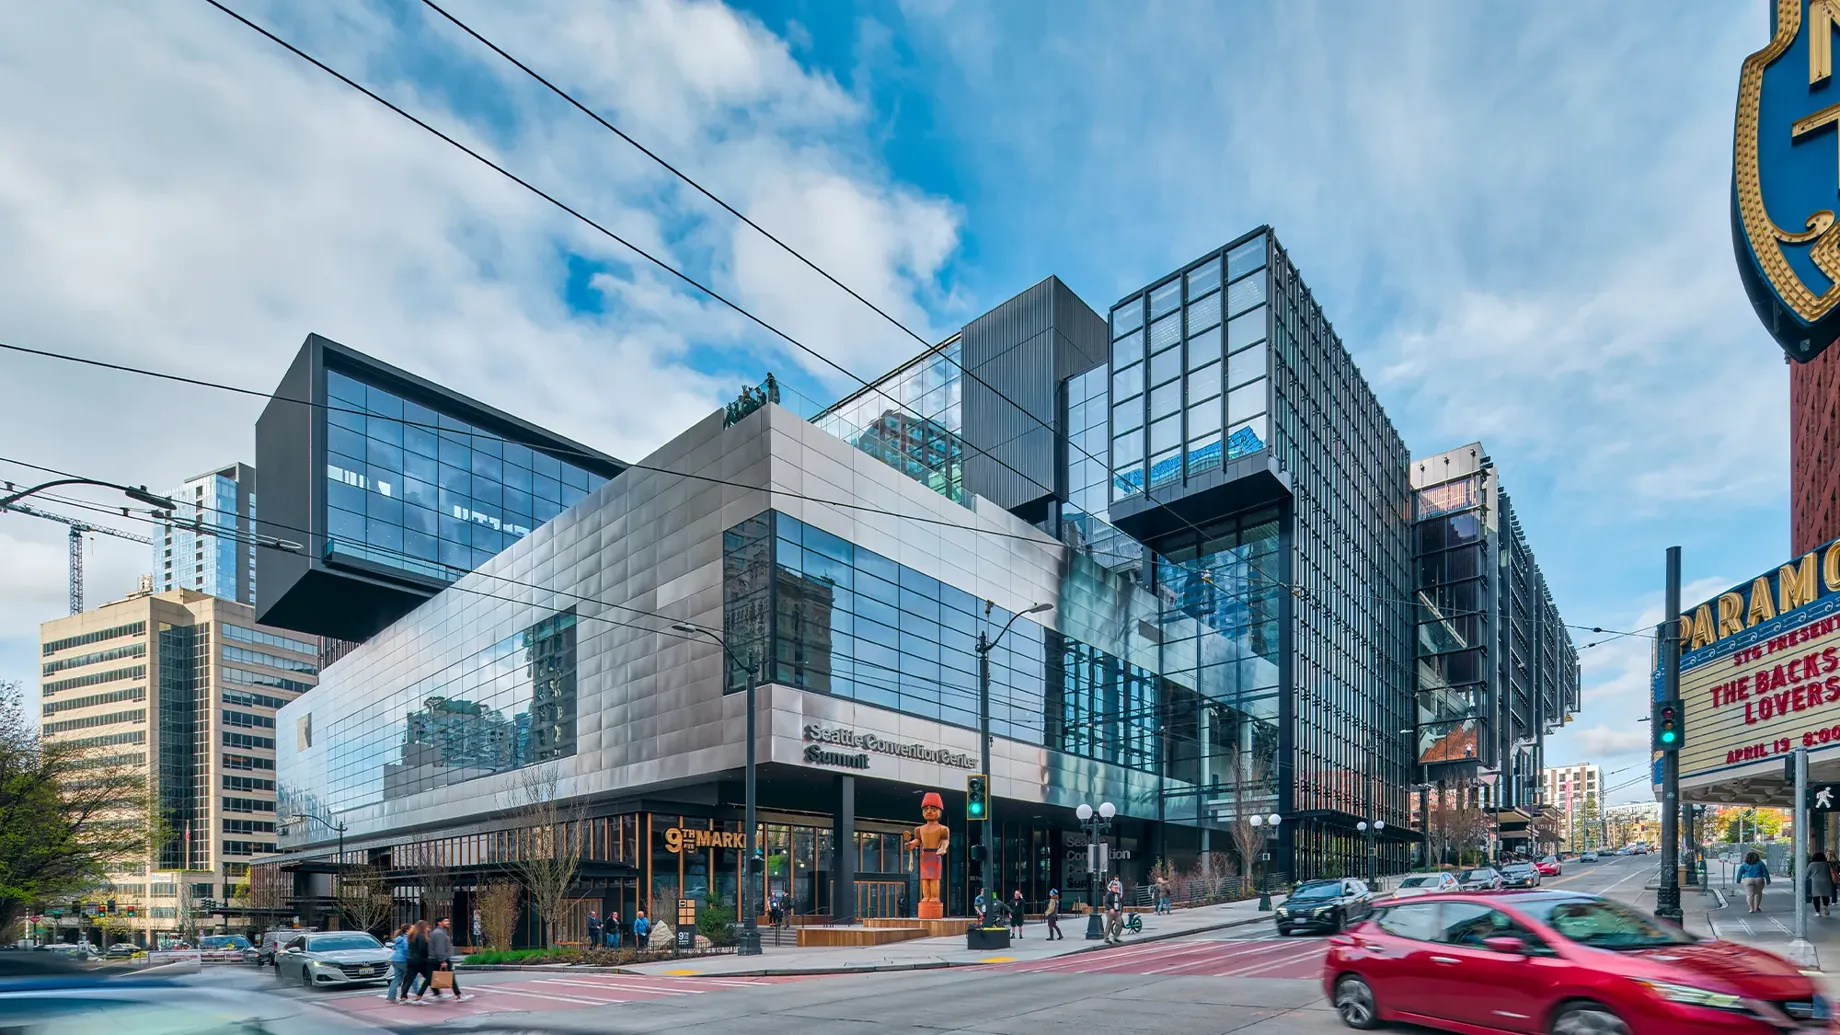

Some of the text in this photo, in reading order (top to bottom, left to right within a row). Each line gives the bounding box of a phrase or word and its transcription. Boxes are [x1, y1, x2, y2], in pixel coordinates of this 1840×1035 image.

[1733, 645, 1763, 666] STG
[1710, 647, 1839, 708] THE BACKS
[1745, 675, 1840, 725] LOVERS
[804, 723, 978, 770] Seattle Convention Center
[804, 745, 870, 770] Summit
[1726, 743, 1769, 764] APRIL
[1773, 737, 1791, 755] 19
[696, 830, 747, 848] MARK
